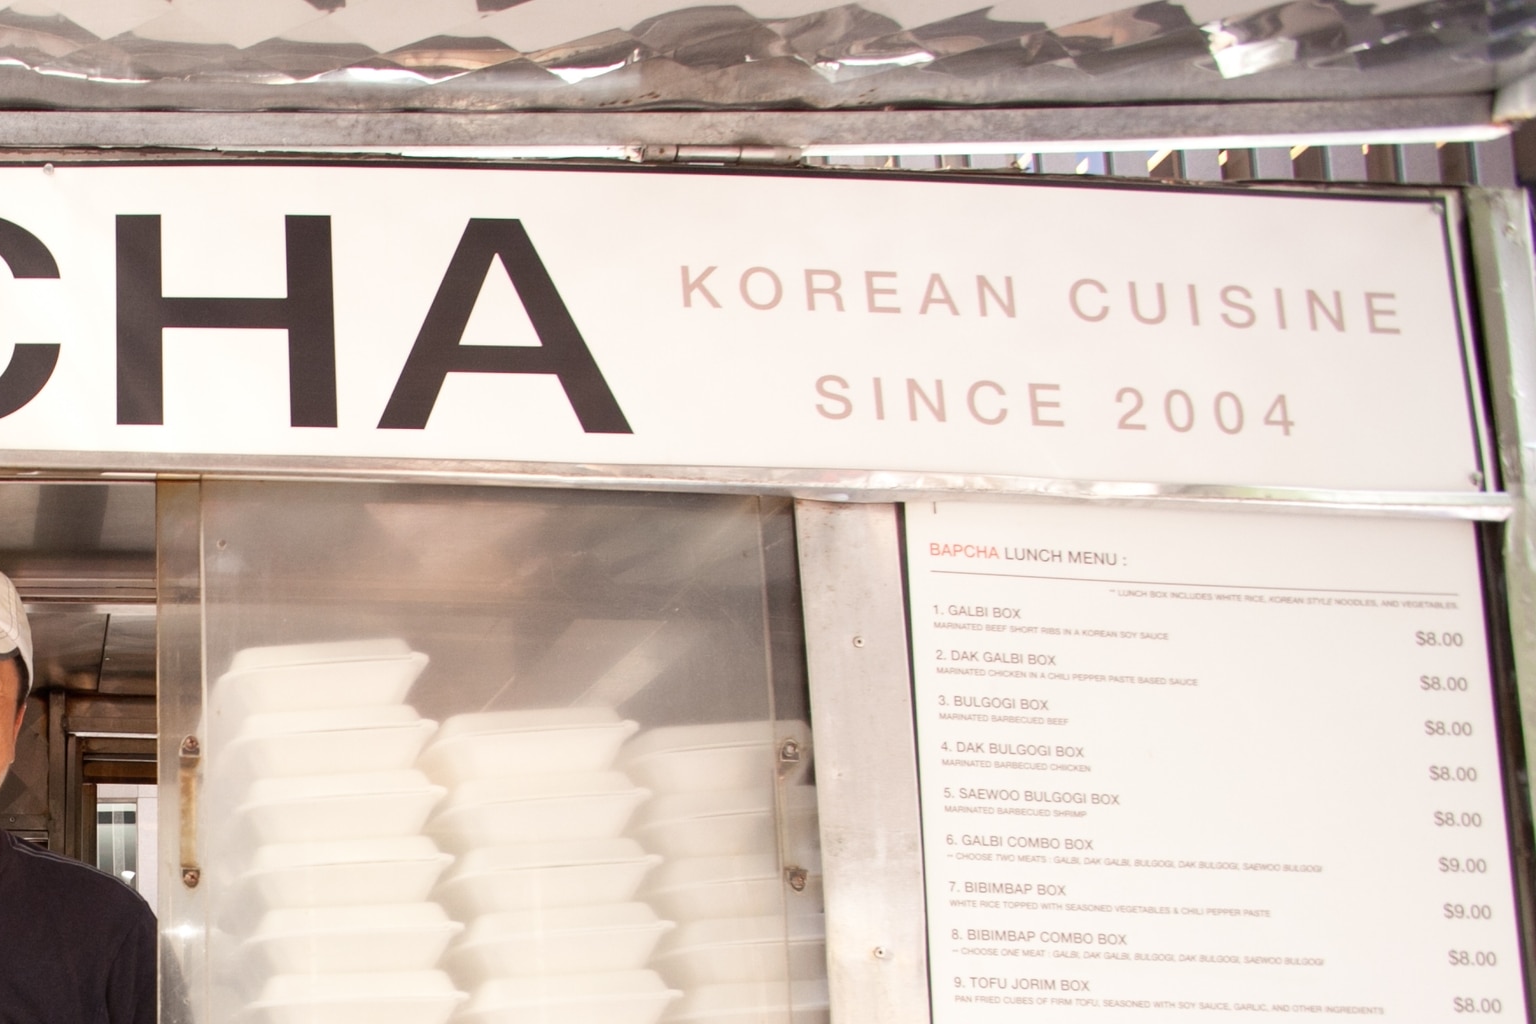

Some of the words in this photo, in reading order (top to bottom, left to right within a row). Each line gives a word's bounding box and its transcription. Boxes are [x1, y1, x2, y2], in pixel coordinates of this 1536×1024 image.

[679, 265, 1017, 318] KOREAN
[1068, 279, 1402, 335] CUISINE
[814, 375, 1065, 427] SINCE
[1115, 387, 1296, 436] 2004
[929, 542, 1000, 559] BAPCHA
[1004, 547, 1062, 563] LUNCH
[1068, 550, 1117, 566] MENU
[933, 605, 944, 615] 1.
[948, 604, 988, 617] GALBI
[992, 607, 1021, 619] BOX
[1416, 630, 1464, 647] $8.00
[1420, 675, 1468, 692] $8.00
[1424, 720, 1473, 737] $8.00
[944, 787, 954, 799] 5.
[959, 787, 1020, 801] SAEWOO
[1024, 790, 1087, 804] BULGOGI
[1091, 793, 1120, 805] BOX
[1438, 856, 1487, 874] $9.00
[949, 881, 959, 892] 7.
[964, 881, 1033, 894] BIBIMBAP
[1037, 884, 1066, 896] BOX
